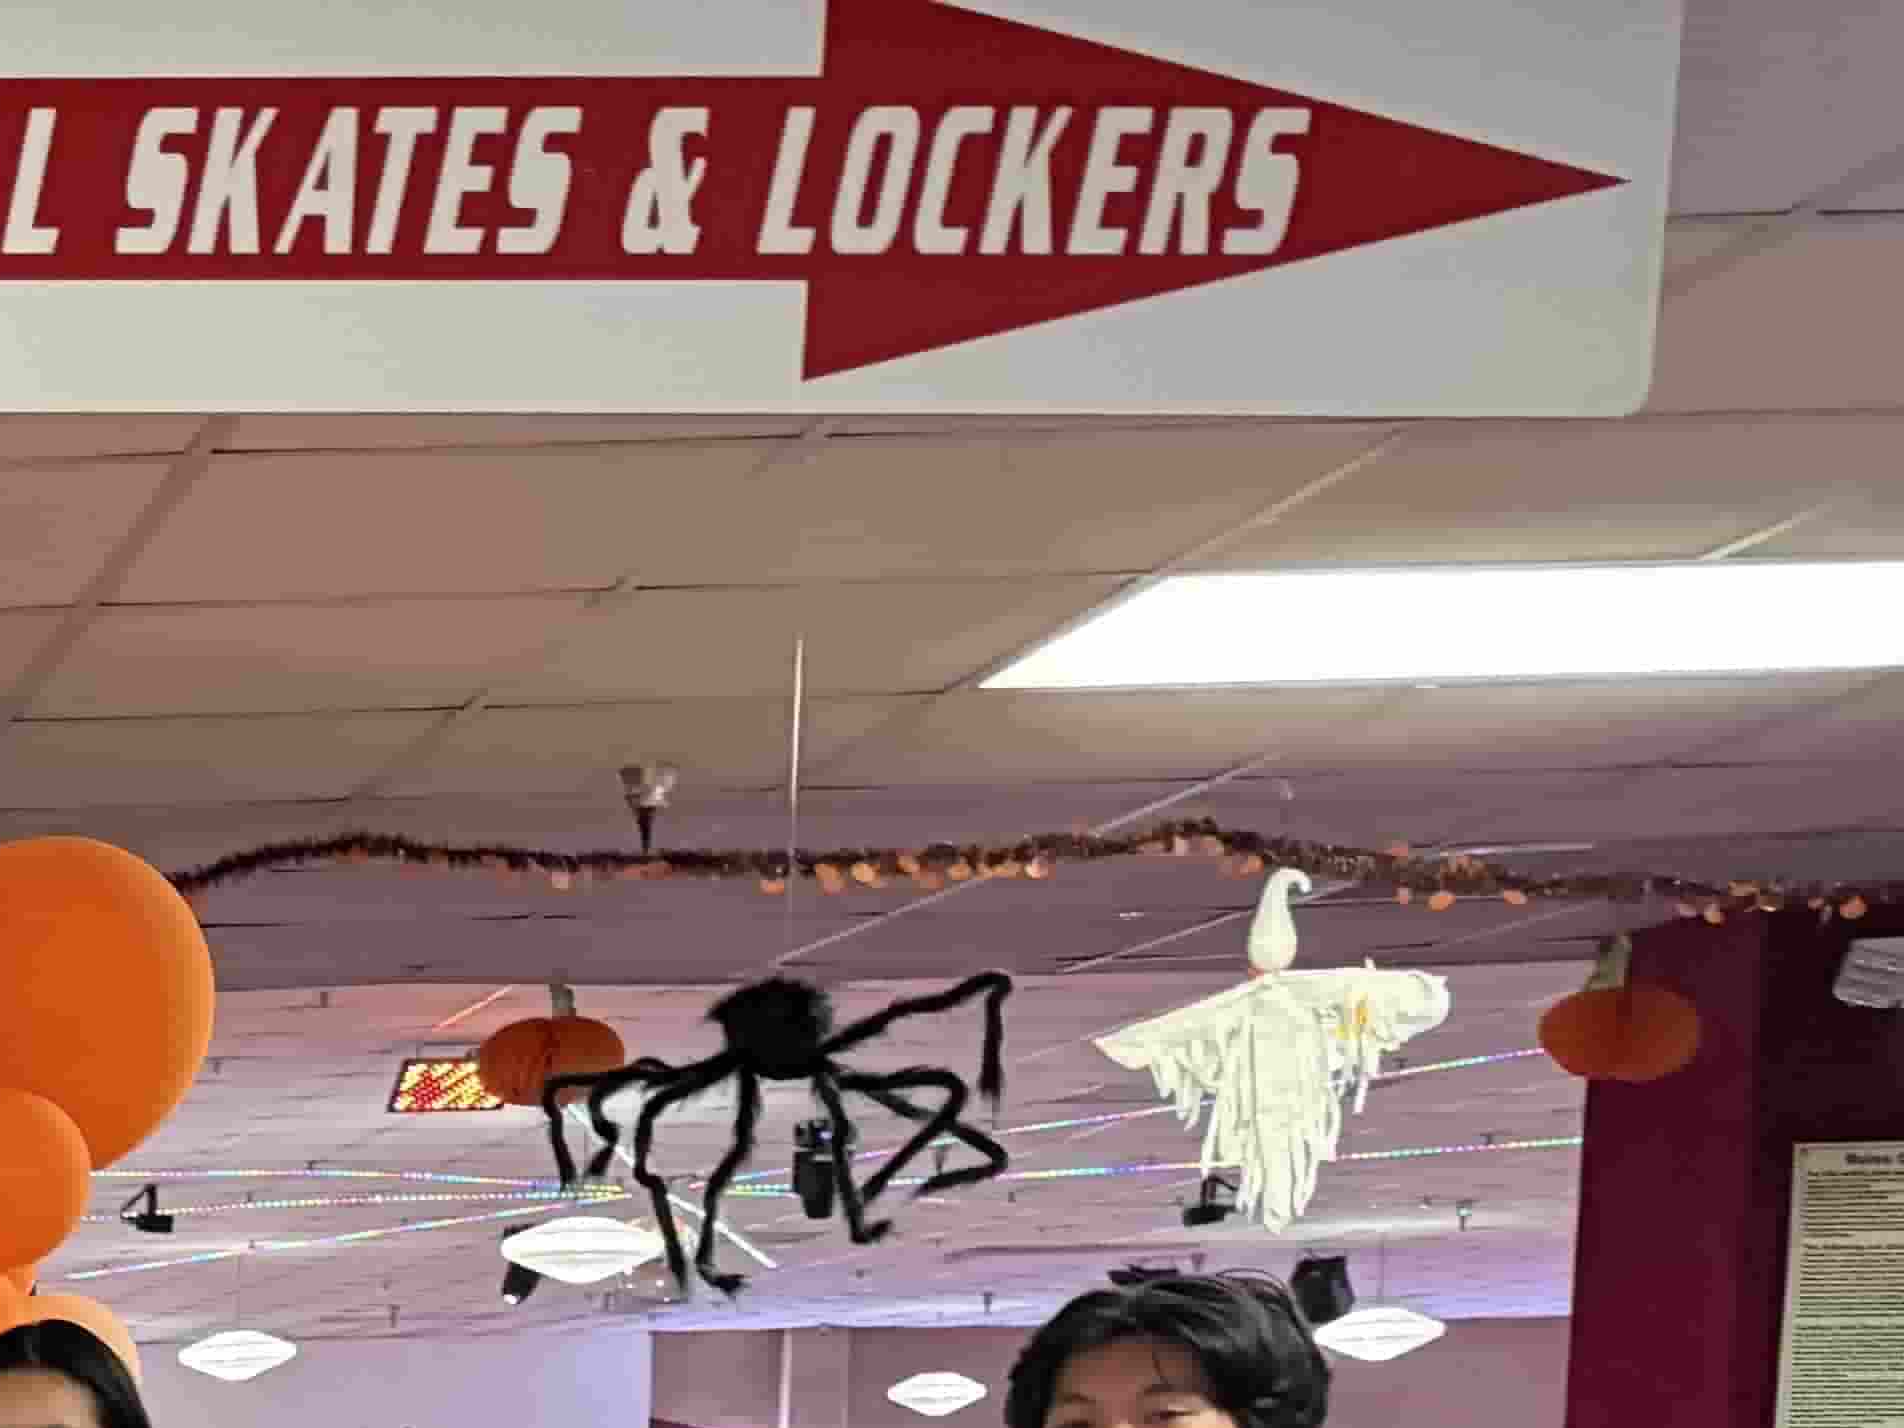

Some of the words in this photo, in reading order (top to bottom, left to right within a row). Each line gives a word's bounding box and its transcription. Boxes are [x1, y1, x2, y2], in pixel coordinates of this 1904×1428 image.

[115, 106, 583, 255] SKATES
[622, 106, 710, 255] &
[756, 105, 1311, 256] LOCKERS
